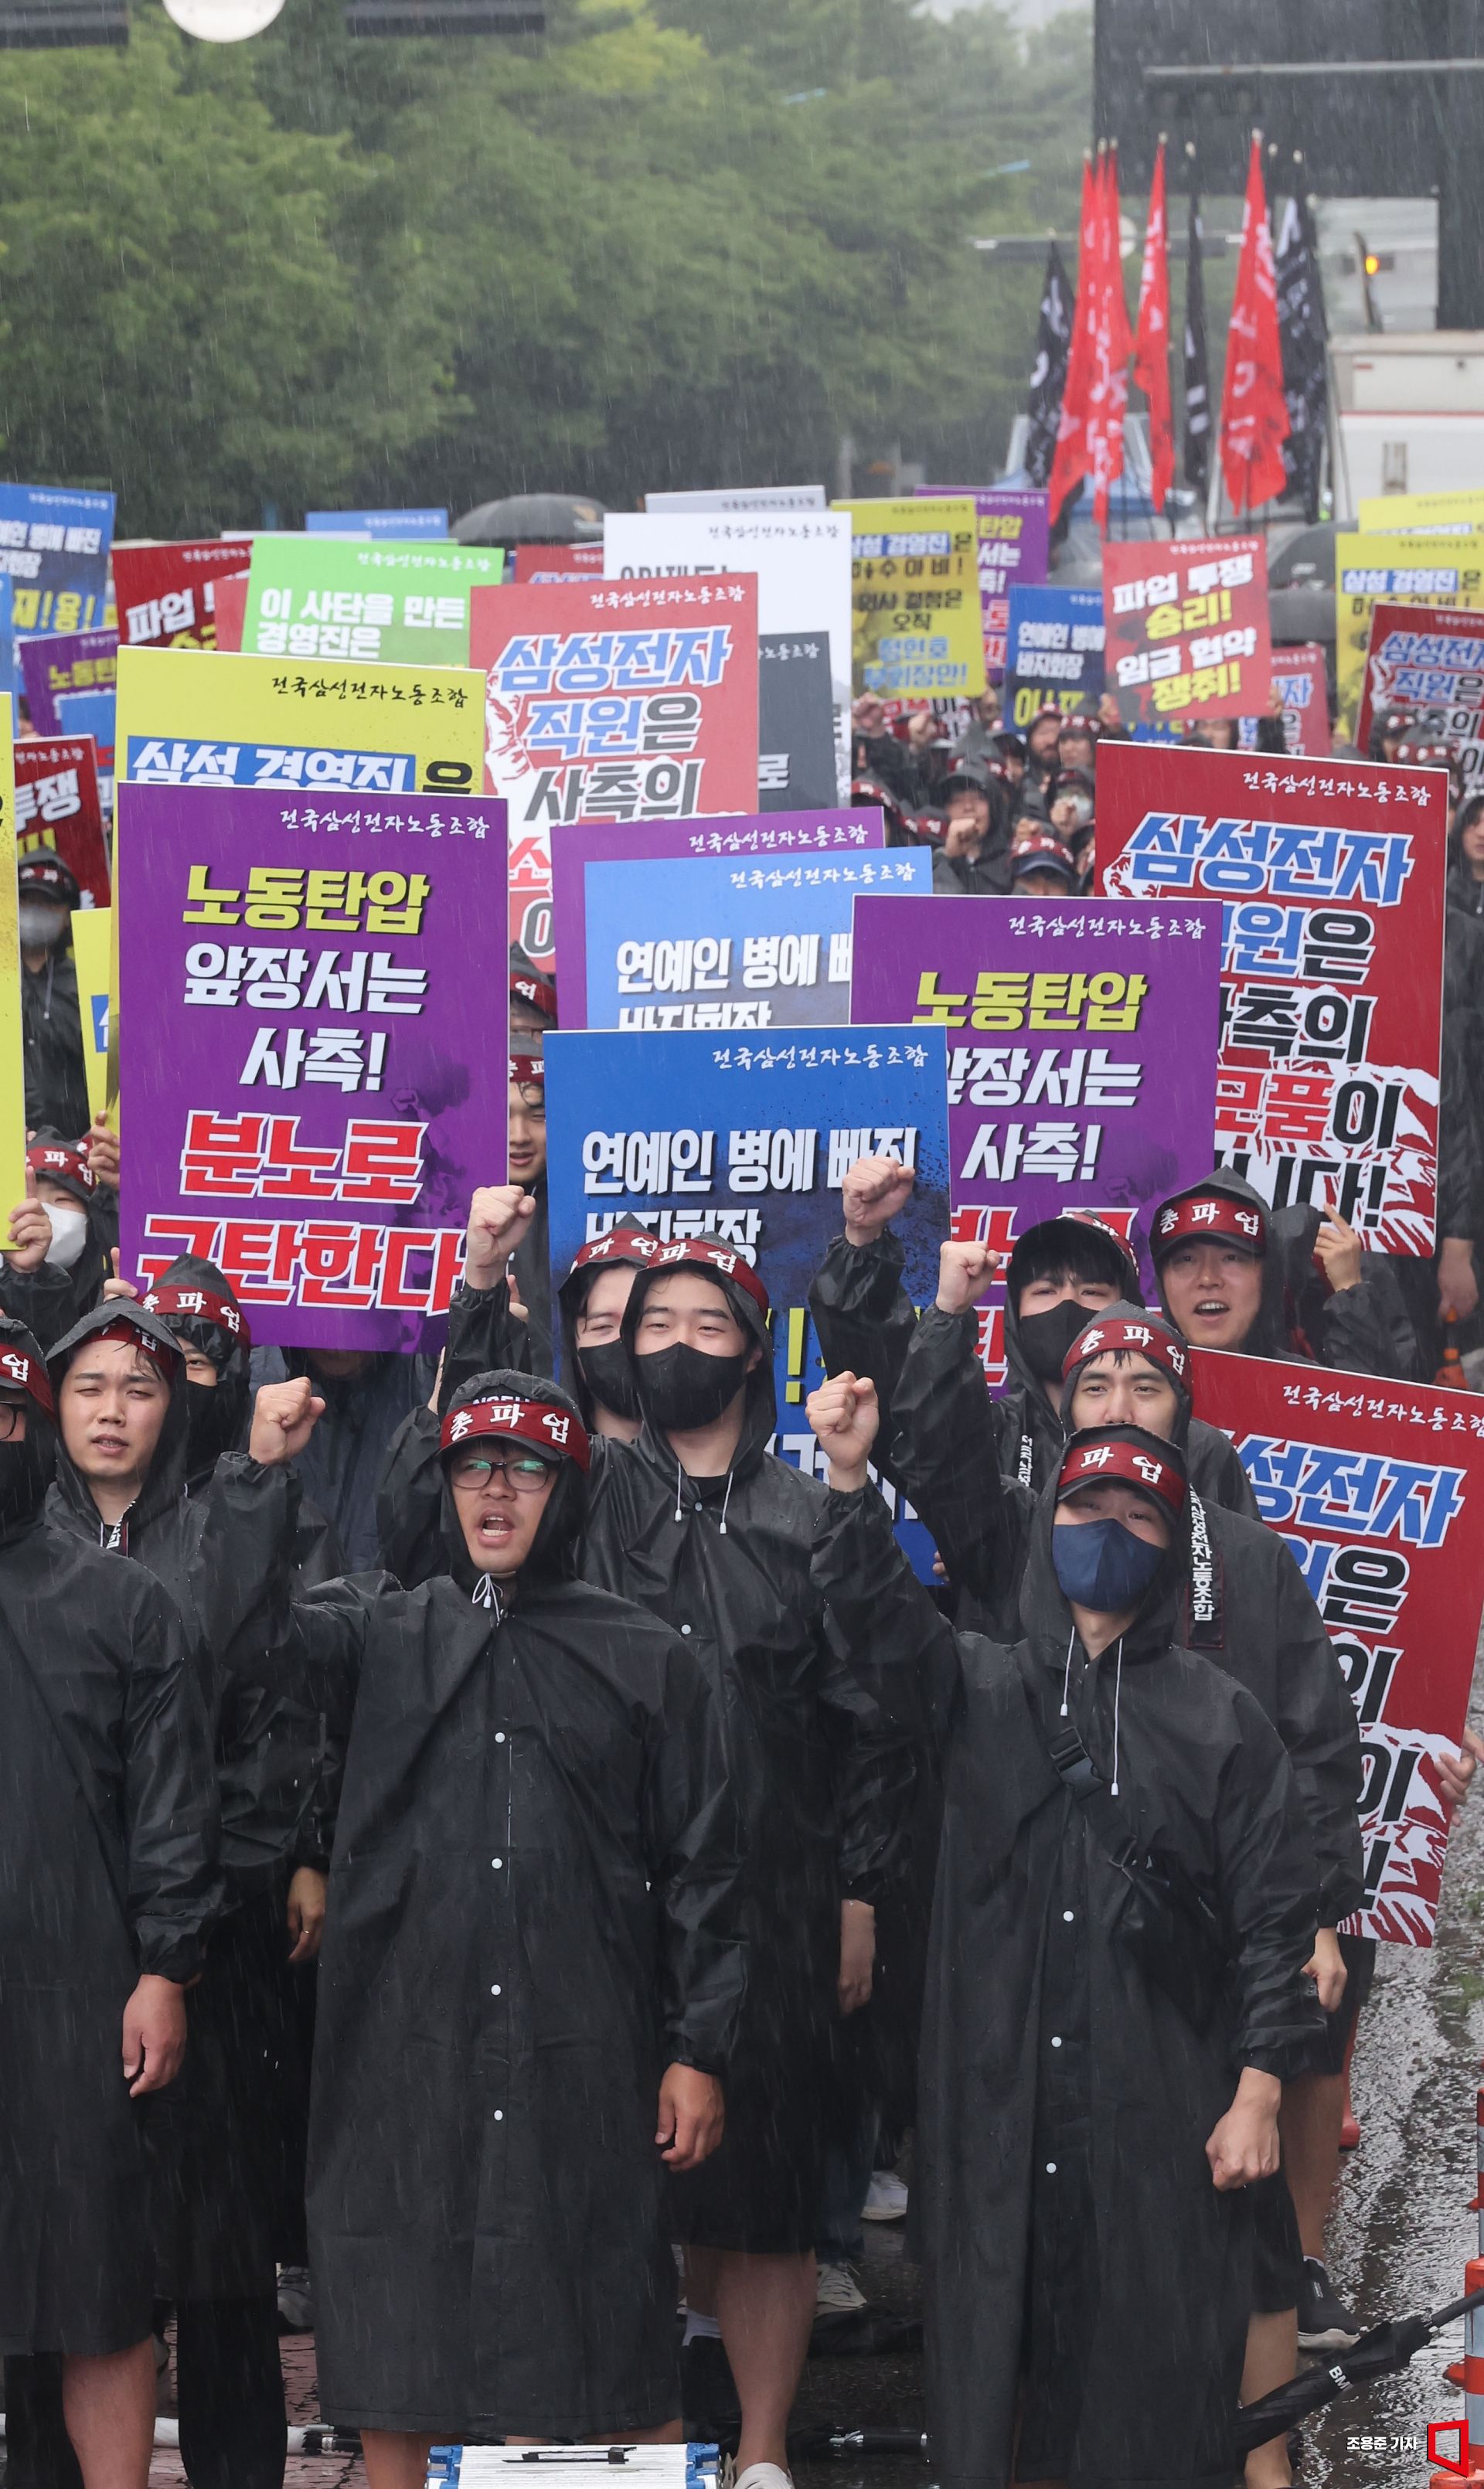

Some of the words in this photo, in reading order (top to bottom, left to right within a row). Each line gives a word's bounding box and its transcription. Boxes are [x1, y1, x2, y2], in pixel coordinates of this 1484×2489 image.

[260, 588, 292, 619] 이
[300, 590, 394, 626] 사단을
[403, 595, 466, 630] 만든
[591, 584, 746, 609] 전국삼성전자노동조합
[1112, 571, 1179, 614] 파업
[1187, 553, 1254, 595] 투쟁
[125, 587, 196, 645] 파업
[257, 621, 381, 659] 경영진은
[1145, 589, 1232, 641] 승리!
[495, 625, 733, 694] 삼성전자
[758, 642, 820, 661] 노동조합
[1115, 645, 1182, 686] 임금
[1189, 627, 1257, 669] 협약
[272, 676, 468, 709] 전국삼성전자노동조합
[1152, 661, 1241, 712] 쟁취!
[522, 692, 703, 761] 직원은
[523, 755, 705, 823] 사측의
[1243, 771, 1431, 806] 전국삼성전자노동조합
[279, 809, 491, 840] 전국삼성전자노동조합
[689, 824, 869, 853] 전국삼성전자노동조합
[730, 863, 917, 889] 전국삼성전자노동조합
[1123, 812, 1414, 907] 삼성전자
[182, 864, 430, 935] 노동탄압
[1008, 914, 1206, 940] 전국삼성전자노동조합
[616, 937, 733, 995] 연예인
[742, 932, 822, 990] 병에
[1223, 901, 1374, 985] 원은
[183, 942, 427, 1014] 앞장서는
[911, 971, 1148, 1031] 노동탄압
[1220, 983, 1378, 1066] 측의
[239, 1027, 387, 1093] 사측!
[713, 1044, 929, 1071] 전국삼성전자노동조합
[179, 1109, 430, 1206] 분노로
[582, 1128, 715, 1195] 연예인
[727, 1128, 819, 1193] 병에
[960, 1122, 1102, 1183] 사측!
[1232, 1429, 1467, 1549] 성전자
